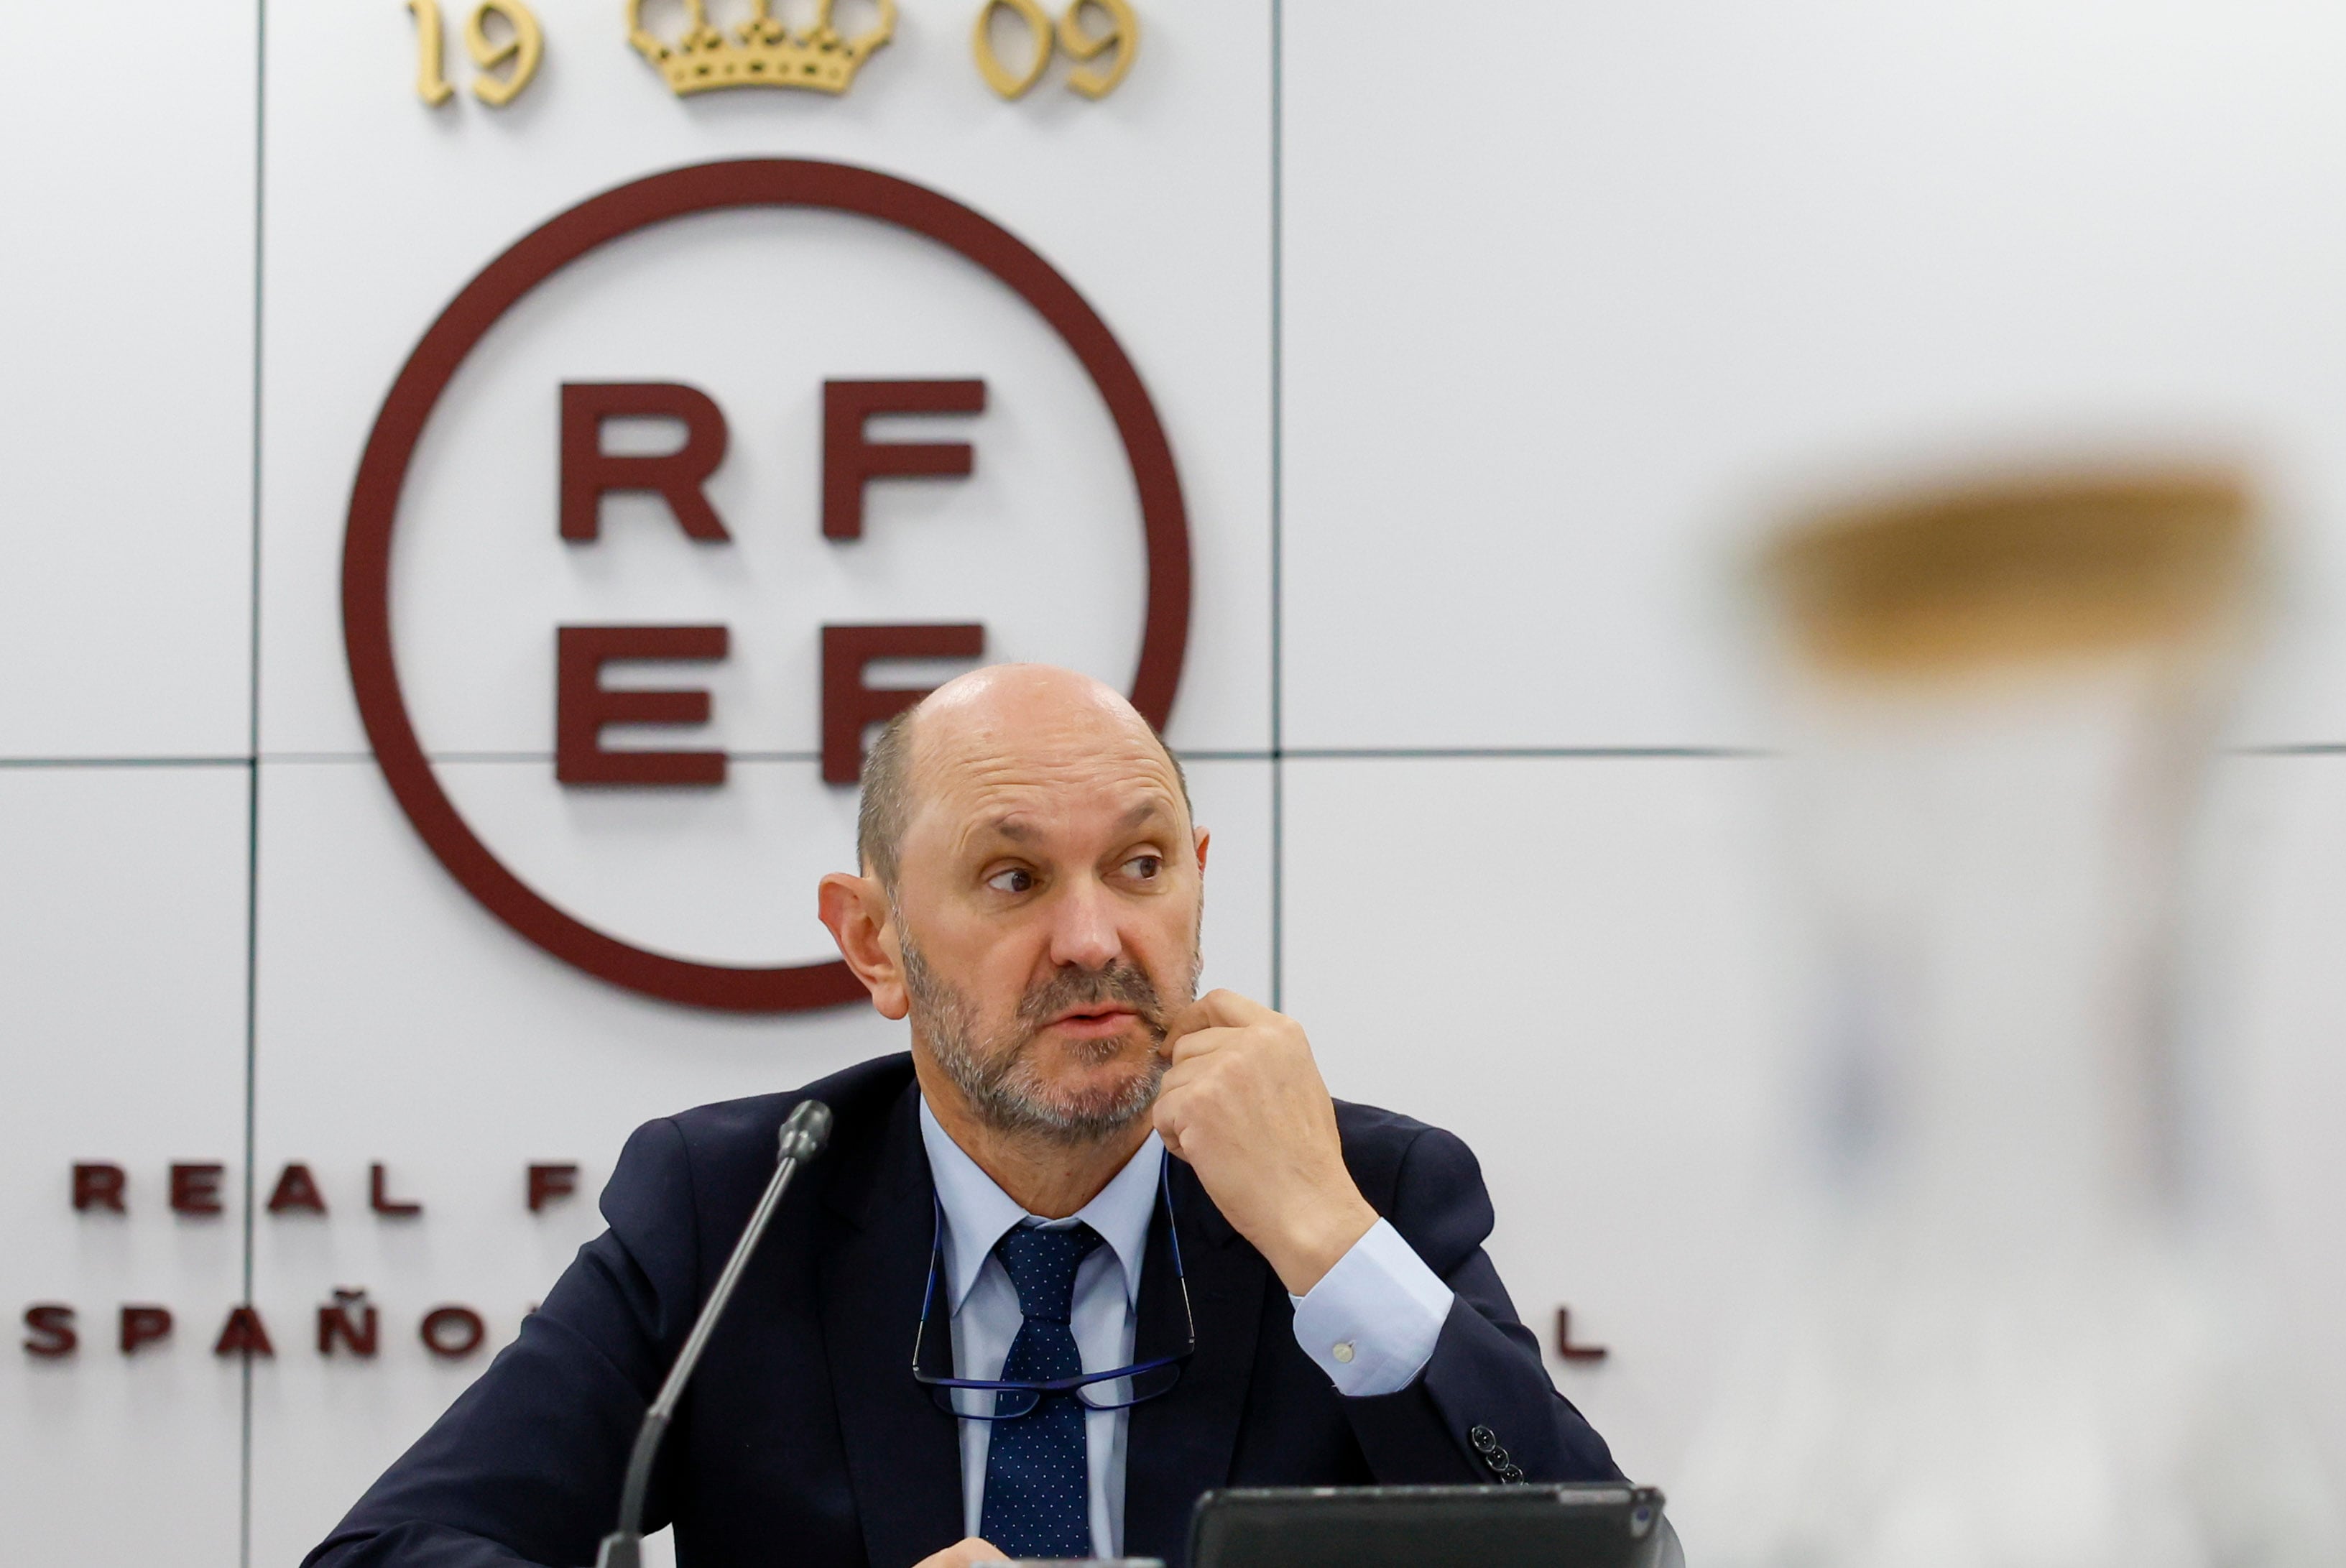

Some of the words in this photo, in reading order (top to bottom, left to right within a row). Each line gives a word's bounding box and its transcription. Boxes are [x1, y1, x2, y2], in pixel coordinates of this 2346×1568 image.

[405, 0, 544, 106] 19
[971, 0, 1141, 101] 09
[73, 1162, 422, 1216] REAL
[25, 1288, 539, 1359] SPAÑO
